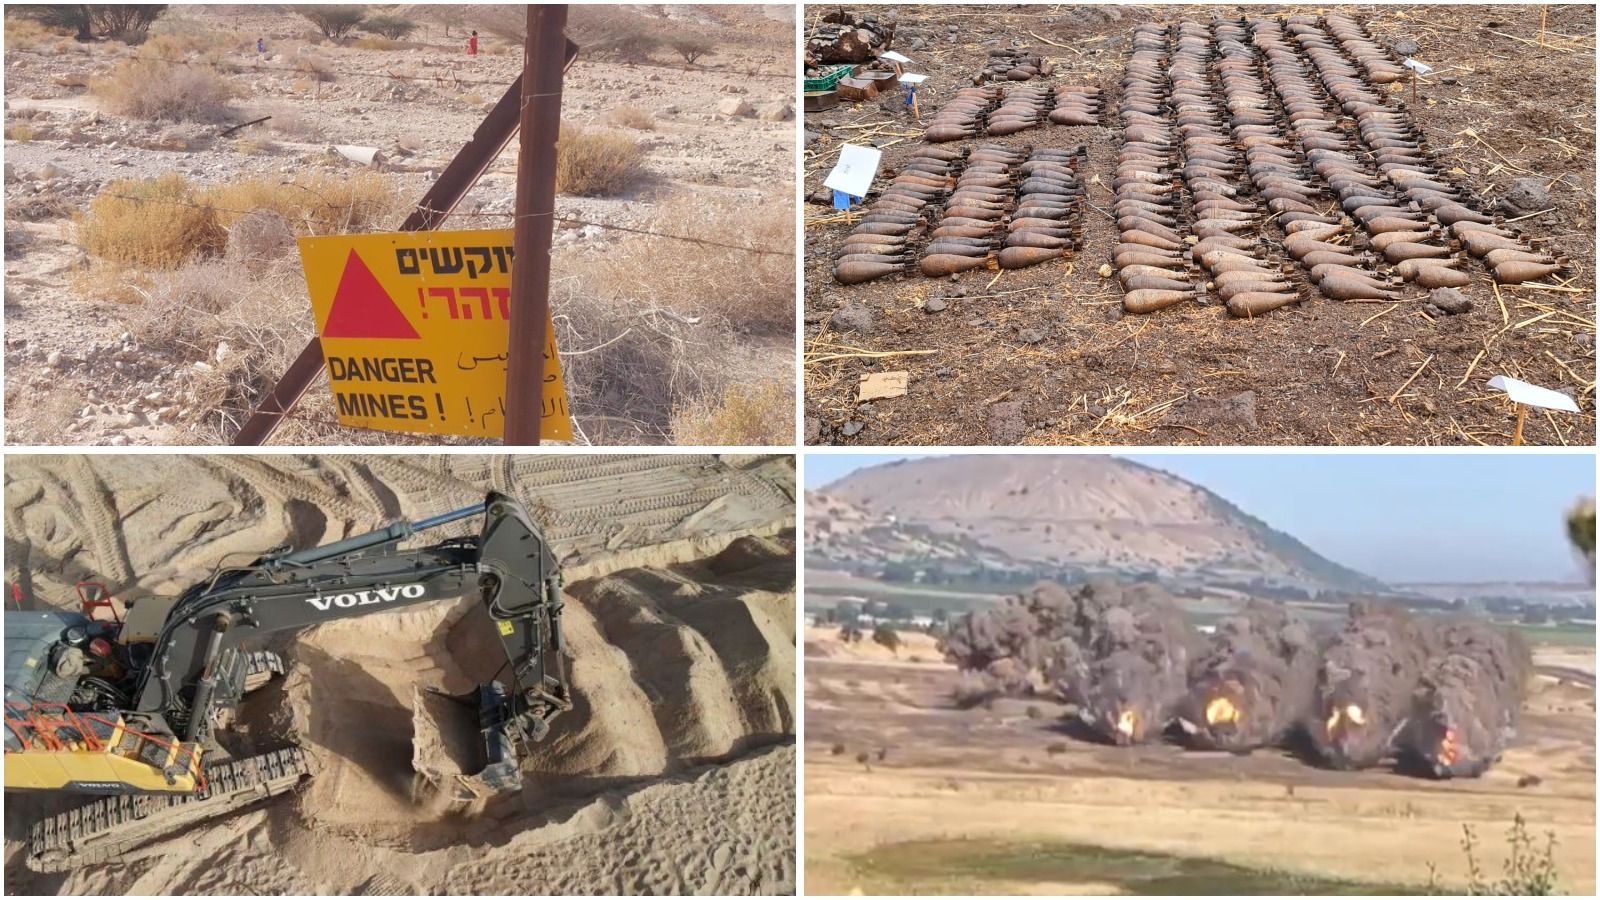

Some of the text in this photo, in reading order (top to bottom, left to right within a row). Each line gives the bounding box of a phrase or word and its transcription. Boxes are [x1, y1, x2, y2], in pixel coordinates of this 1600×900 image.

[418, 287, 511, 320] זהר!
[328, 357, 437, 384] DANGER
[305, 584, 425, 610] VOLVO
